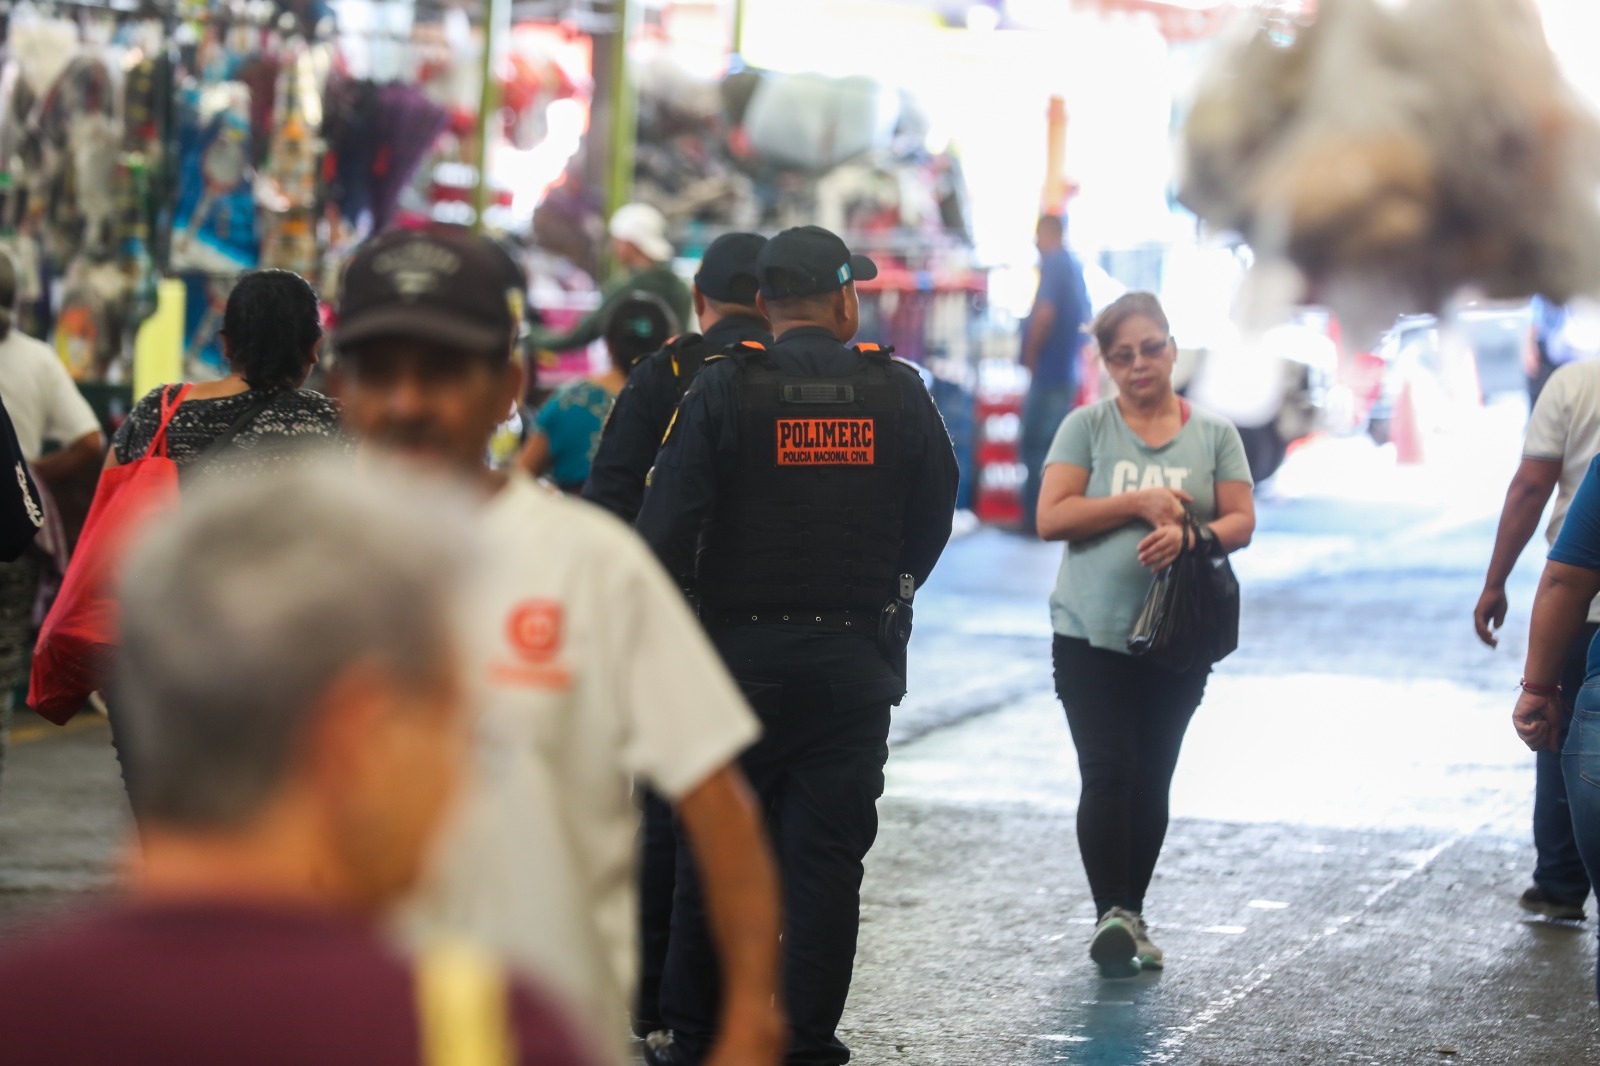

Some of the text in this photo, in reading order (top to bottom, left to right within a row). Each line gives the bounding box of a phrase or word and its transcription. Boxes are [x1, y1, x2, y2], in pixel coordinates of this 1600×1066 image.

[780, 422, 872, 448] POLIMERC
[783, 451, 868, 462] POLICIA NACIONAL CIVIL
[1111, 460, 1189, 497] CAT
